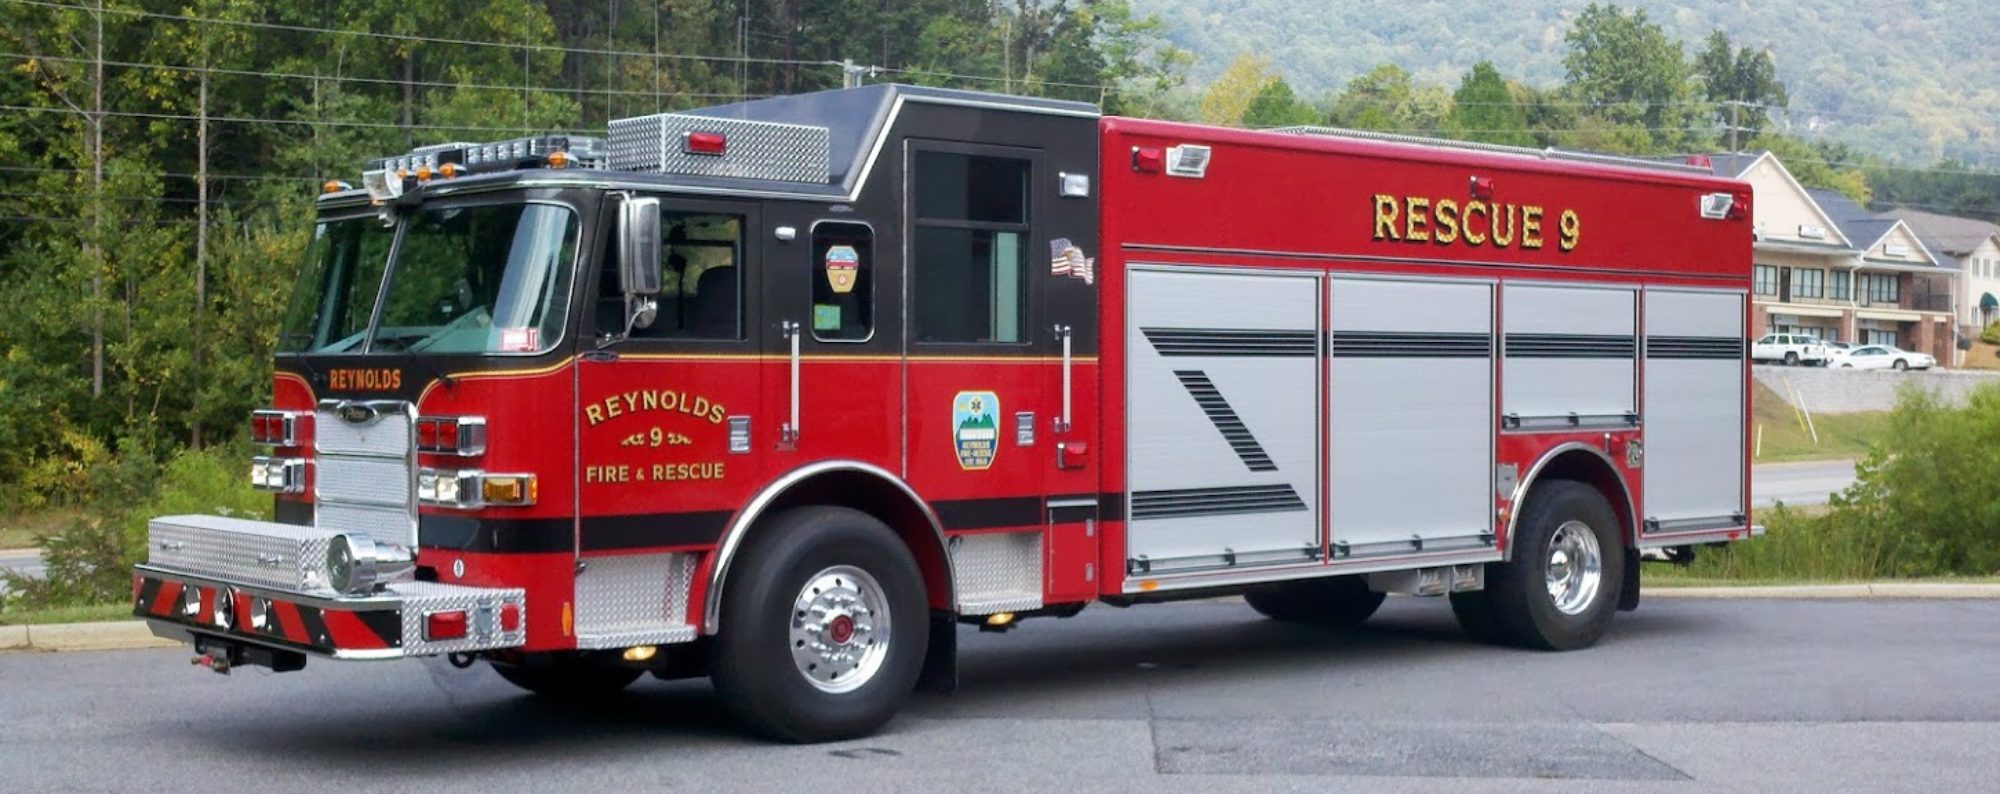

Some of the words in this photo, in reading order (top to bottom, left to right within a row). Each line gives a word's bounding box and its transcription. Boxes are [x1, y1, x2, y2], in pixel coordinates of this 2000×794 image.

[1372, 193, 1544, 247] RESCUE
[1559, 208, 1580, 250] 9
[329, 368, 402, 389] REYNOLDS
[585, 390, 725, 425] REYNOLDS
[650, 427, 663, 447] 9
[586, 464, 629, 483] FIRE
[635, 468, 645, 481] &
[653, 462, 725, 480] RESCUE
